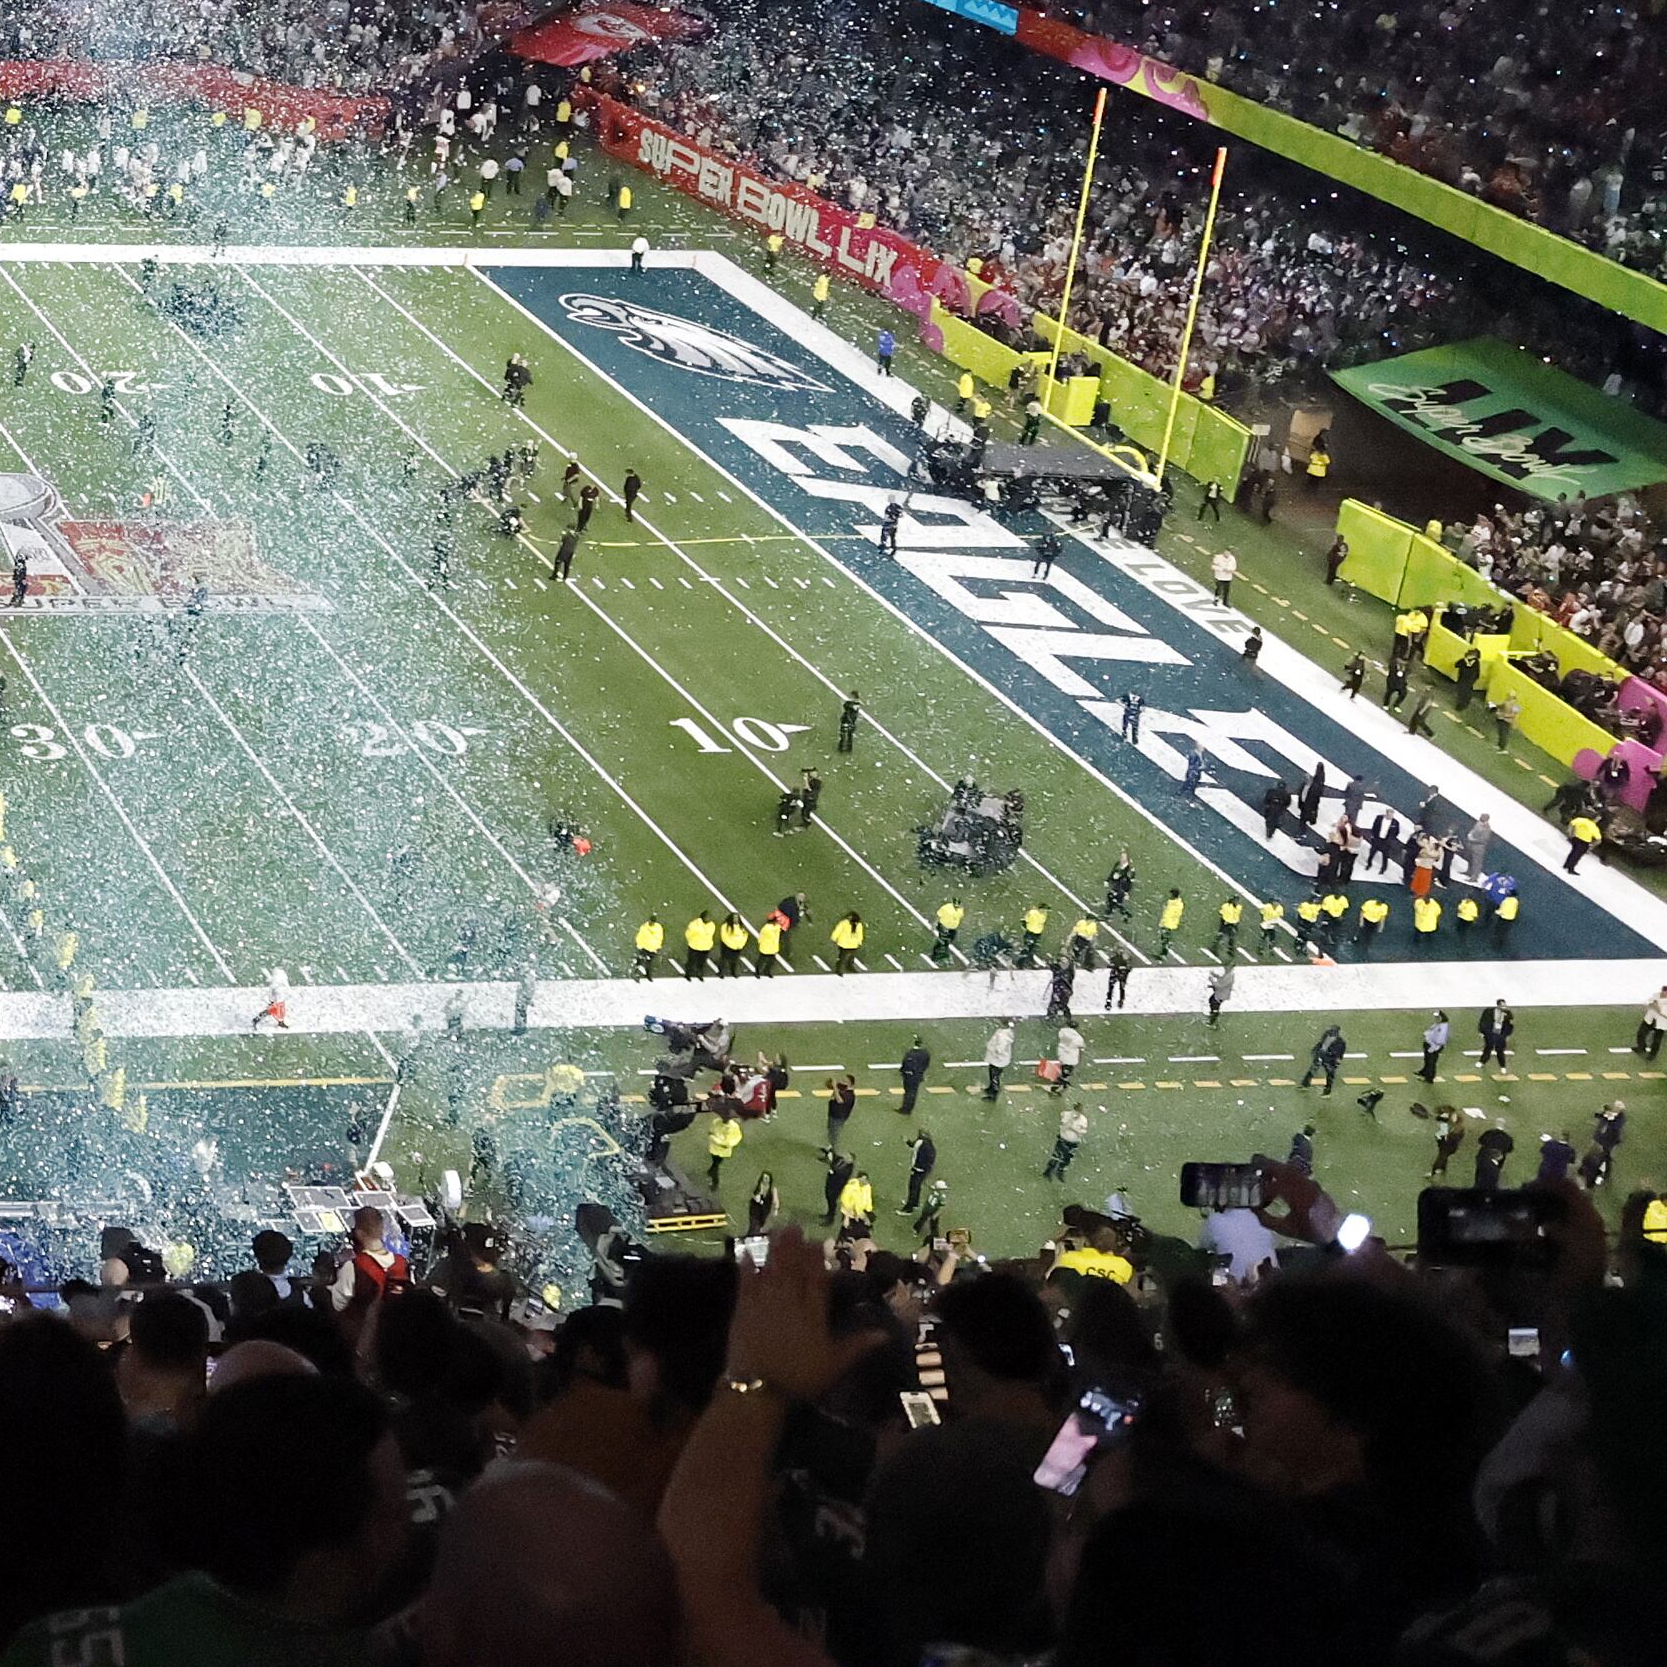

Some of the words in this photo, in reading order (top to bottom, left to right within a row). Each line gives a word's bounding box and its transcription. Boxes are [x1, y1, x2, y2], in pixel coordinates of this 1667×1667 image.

[638, 128, 736, 208] SUPER
[737, 175, 833, 260] BOWL
[836, 226, 899, 289] LIX
[1125, 564, 1255, 633] LOVE
[714, 414, 1492, 887] EAGLES
[9, 722, 136, 760] 30
[668, 716, 790, 753] 10
